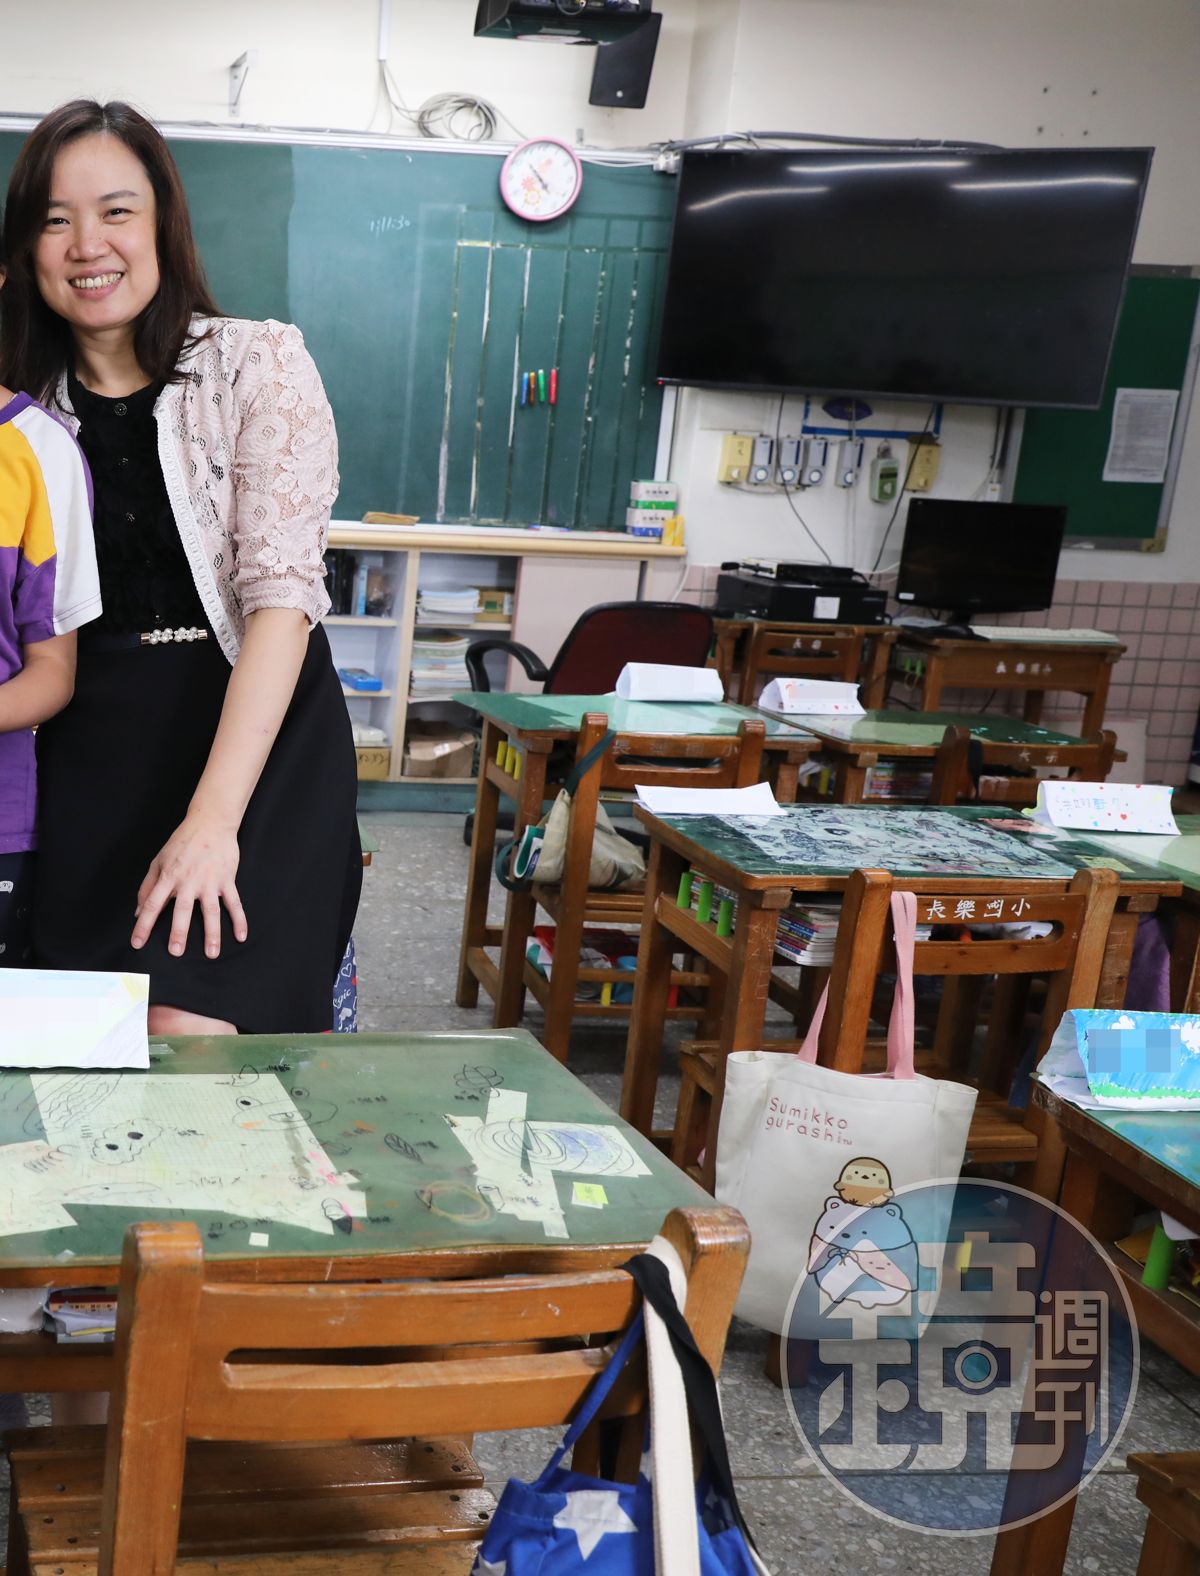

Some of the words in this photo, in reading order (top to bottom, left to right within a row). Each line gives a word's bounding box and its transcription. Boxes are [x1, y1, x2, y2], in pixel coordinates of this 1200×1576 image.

[926, 898, 1031, 920] 長樂國小
[770, 1097, 848, 1130] Sumikko
